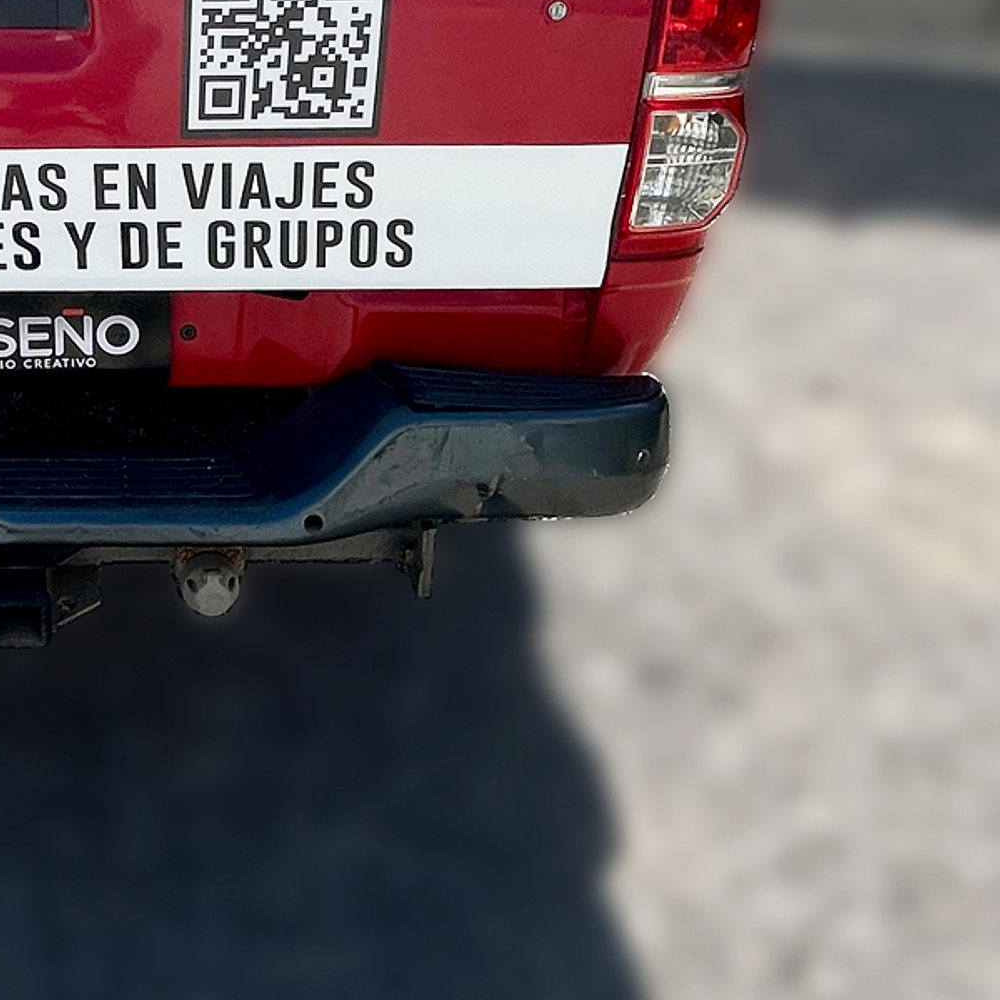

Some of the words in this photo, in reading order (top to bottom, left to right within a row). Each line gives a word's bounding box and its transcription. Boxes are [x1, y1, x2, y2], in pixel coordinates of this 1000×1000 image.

[93, 163, 157, 210] EN
[181, 161, 375, 209] VIAJES
[64, 222, 96, 269] Y
[120, 221, 183, 269] DE
[207, 219, 414, 268] GRUPOS
[23, 357, 97, 370] CREATIVO
